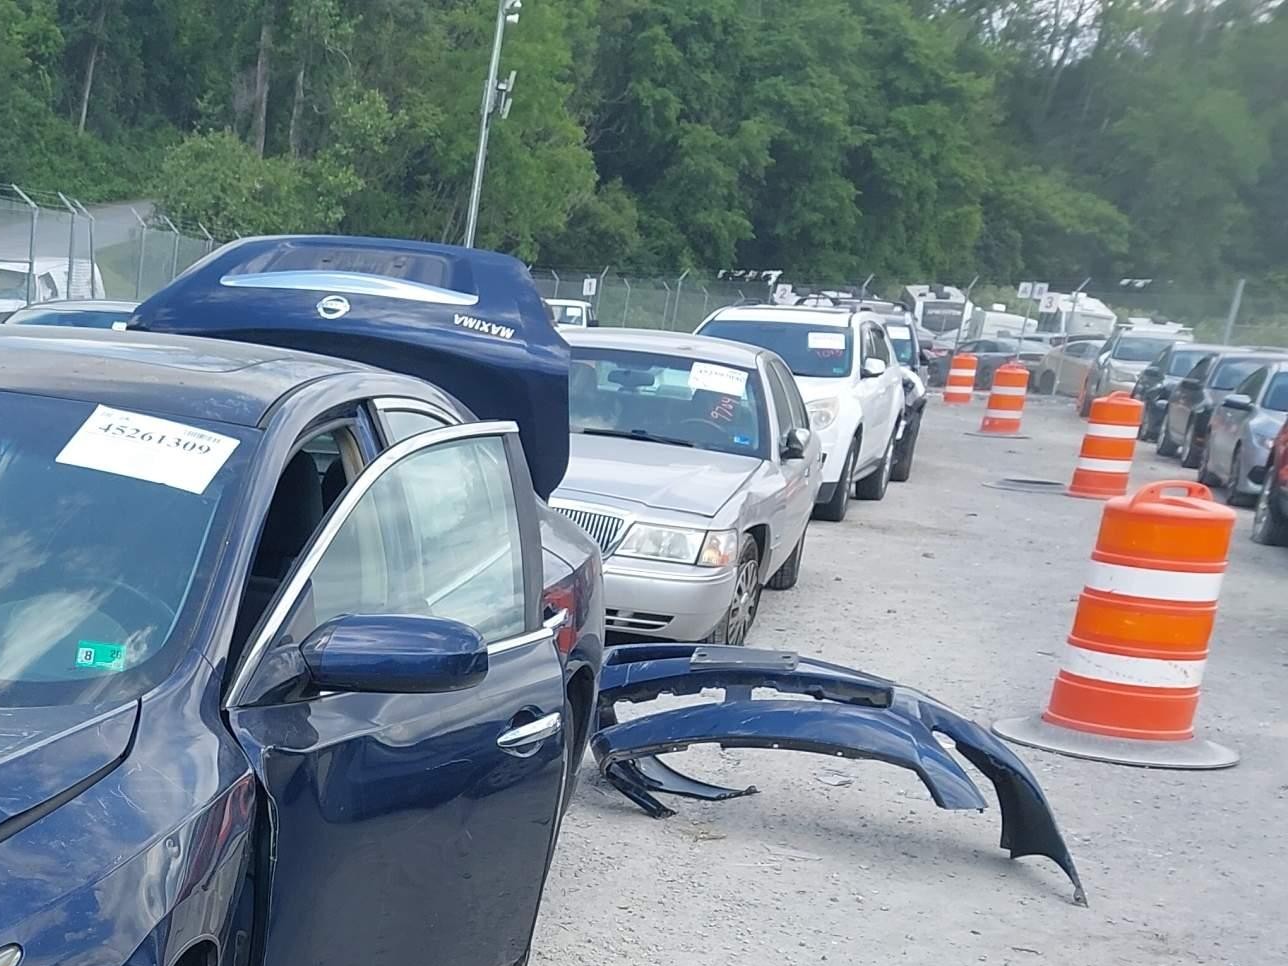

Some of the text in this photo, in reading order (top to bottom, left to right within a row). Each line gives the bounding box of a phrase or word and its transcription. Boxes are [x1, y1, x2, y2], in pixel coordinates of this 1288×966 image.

[778, 287, 788, 299] 2
[1044, 295, 1055, 309] 3
[453, 313, 516, 339] MAXIMA
[98, 422, 211, 455] 45261309
[84, 650, 93, 661] 8
